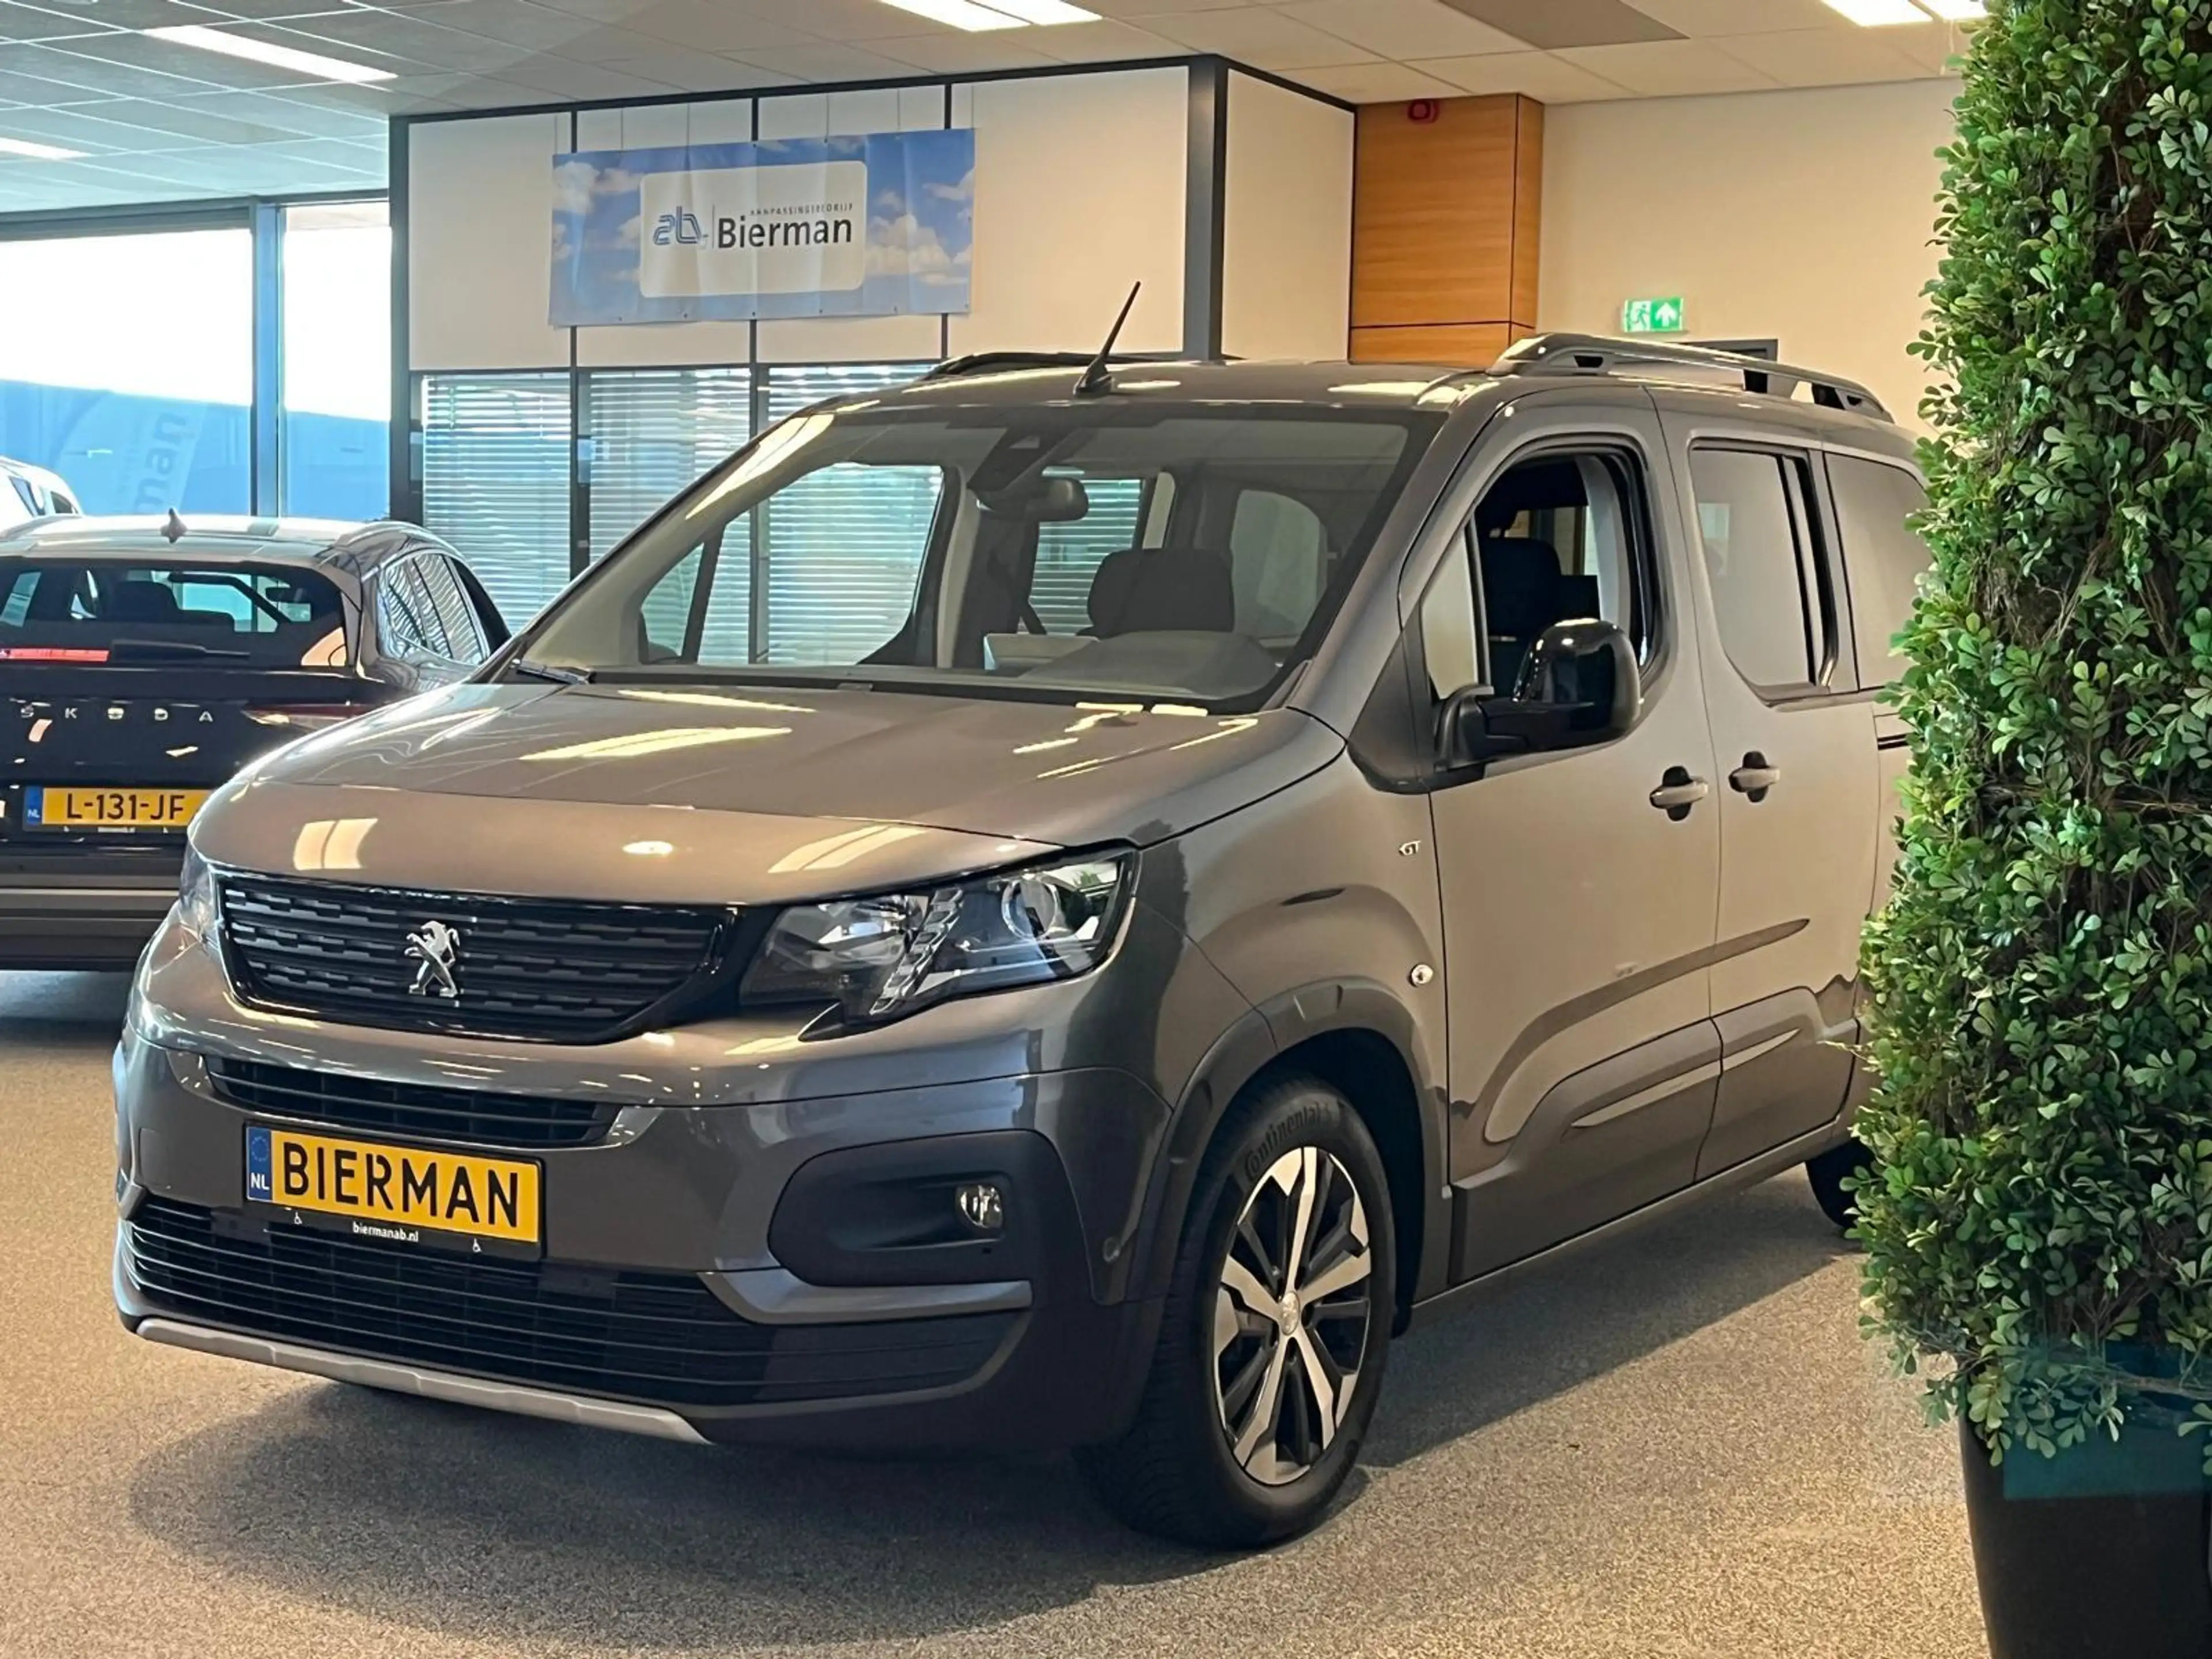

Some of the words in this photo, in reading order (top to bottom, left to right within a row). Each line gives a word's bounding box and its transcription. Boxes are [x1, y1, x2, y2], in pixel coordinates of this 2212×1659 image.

[718, 215, 853, 249] Bierman
[27, 809, 40, 819] NL
[66, 793, 185, 820] L-131-JF
[250, 1172, 270, 1191] NL
[283, 1141, 518, 1228] BIERMAN
[352, 1221, 419, 1244] biermanab.nl
